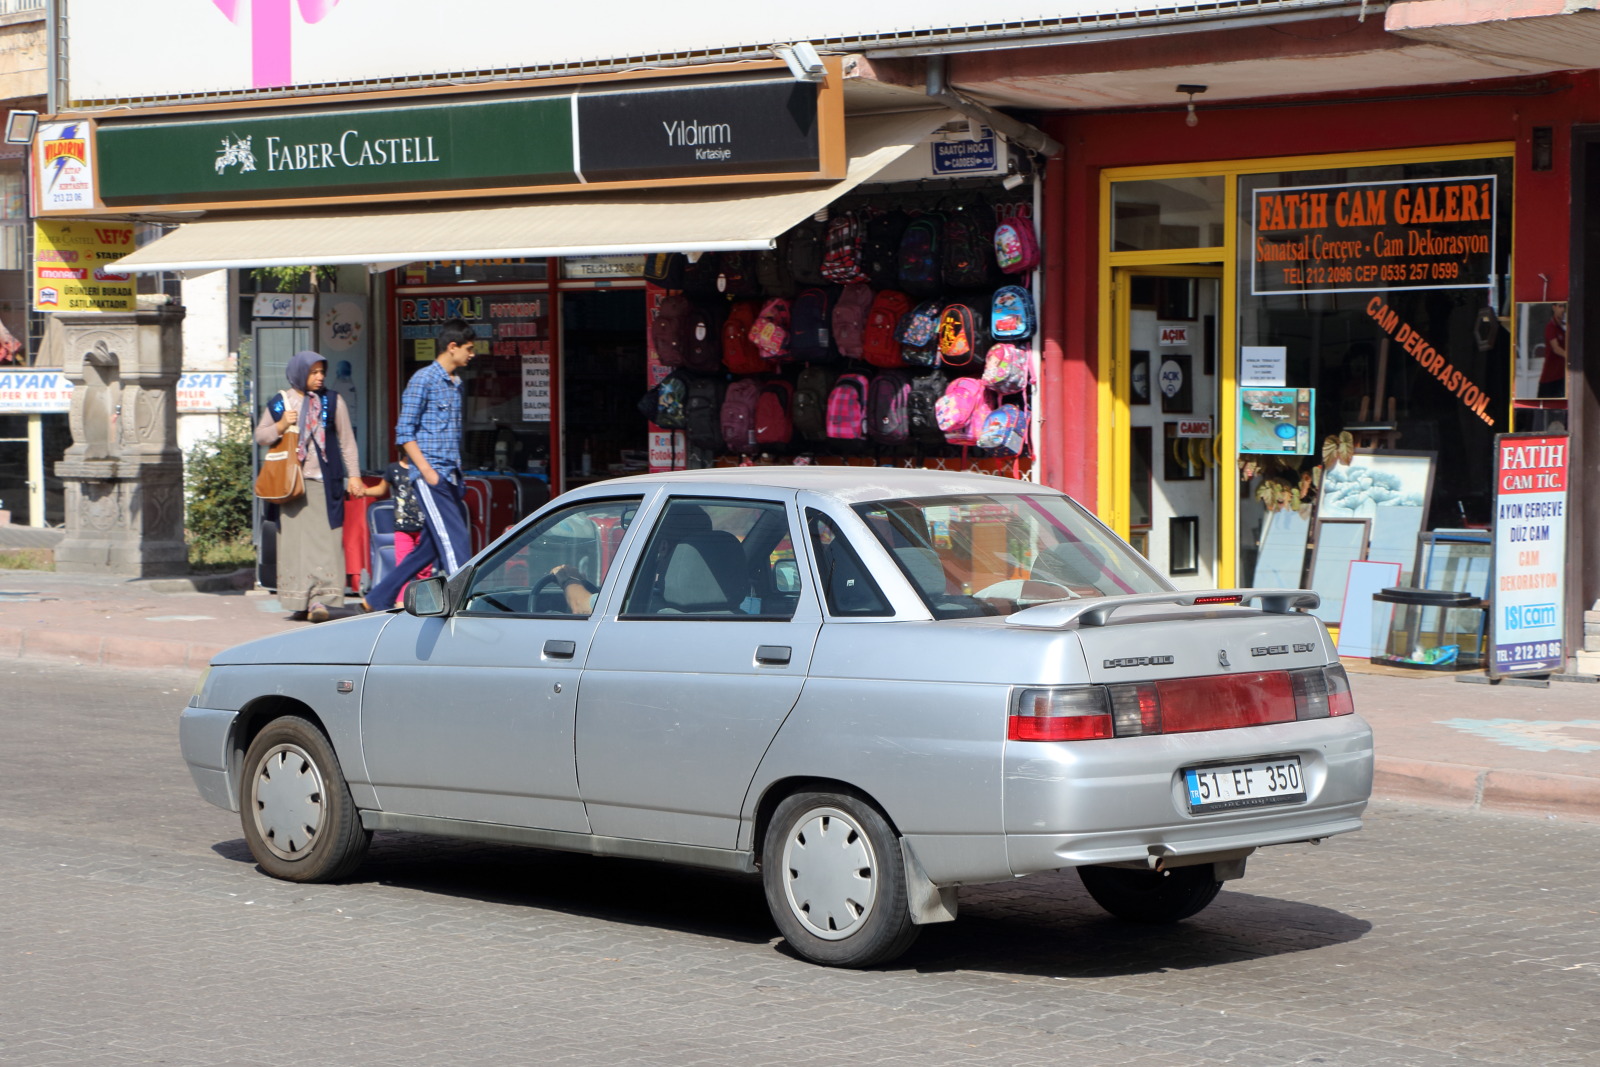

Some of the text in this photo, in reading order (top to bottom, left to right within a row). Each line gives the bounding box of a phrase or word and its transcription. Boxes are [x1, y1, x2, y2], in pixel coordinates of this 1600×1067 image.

[266, 130, 440, 171] FABER-CASTELL
[967, 142, 989, 154] HOCA
[66, 194, 73, 202] 23
[1335, 190, 1387, 228] CAM
[1257, 235, 1309, 263] Sanatsal
[1312, 234, 1362, 264] Çerçeve
[1374, 232, 1403, 258] Cam
[1408, 230, 1489, 264] Dekorasyon
[1283, 262, 1459, 284] TEL 212 2096 CEP 0535 257 0599
[102, 287, 132, 296] BURADA
[1366, 296, 1395, 334] CAM
[1162, 330, 1186, 344] AÇIK
[1180, 422, 1209, 434] CAMCI
[1503, 474, 1533, 490] CAM
[1500, 502, 1563, 522] AYON ÇERÇEVE
[1510, 525, 1550, 542] DÜZ CAM
[1519, 550, 1540, 566] CAM
[1500, 573, 1558, 592] DEKORASYON
[1514, 645, 1533, 660] 212
[1535, 644, 1547, 659] 20
[1549, 642, 1560, 657] 96
[1104, 657, 1149, 669] LADA
[1198, 764, 1299, 800] 51 EF 350
[1190, 790, 1200, 798] TR
